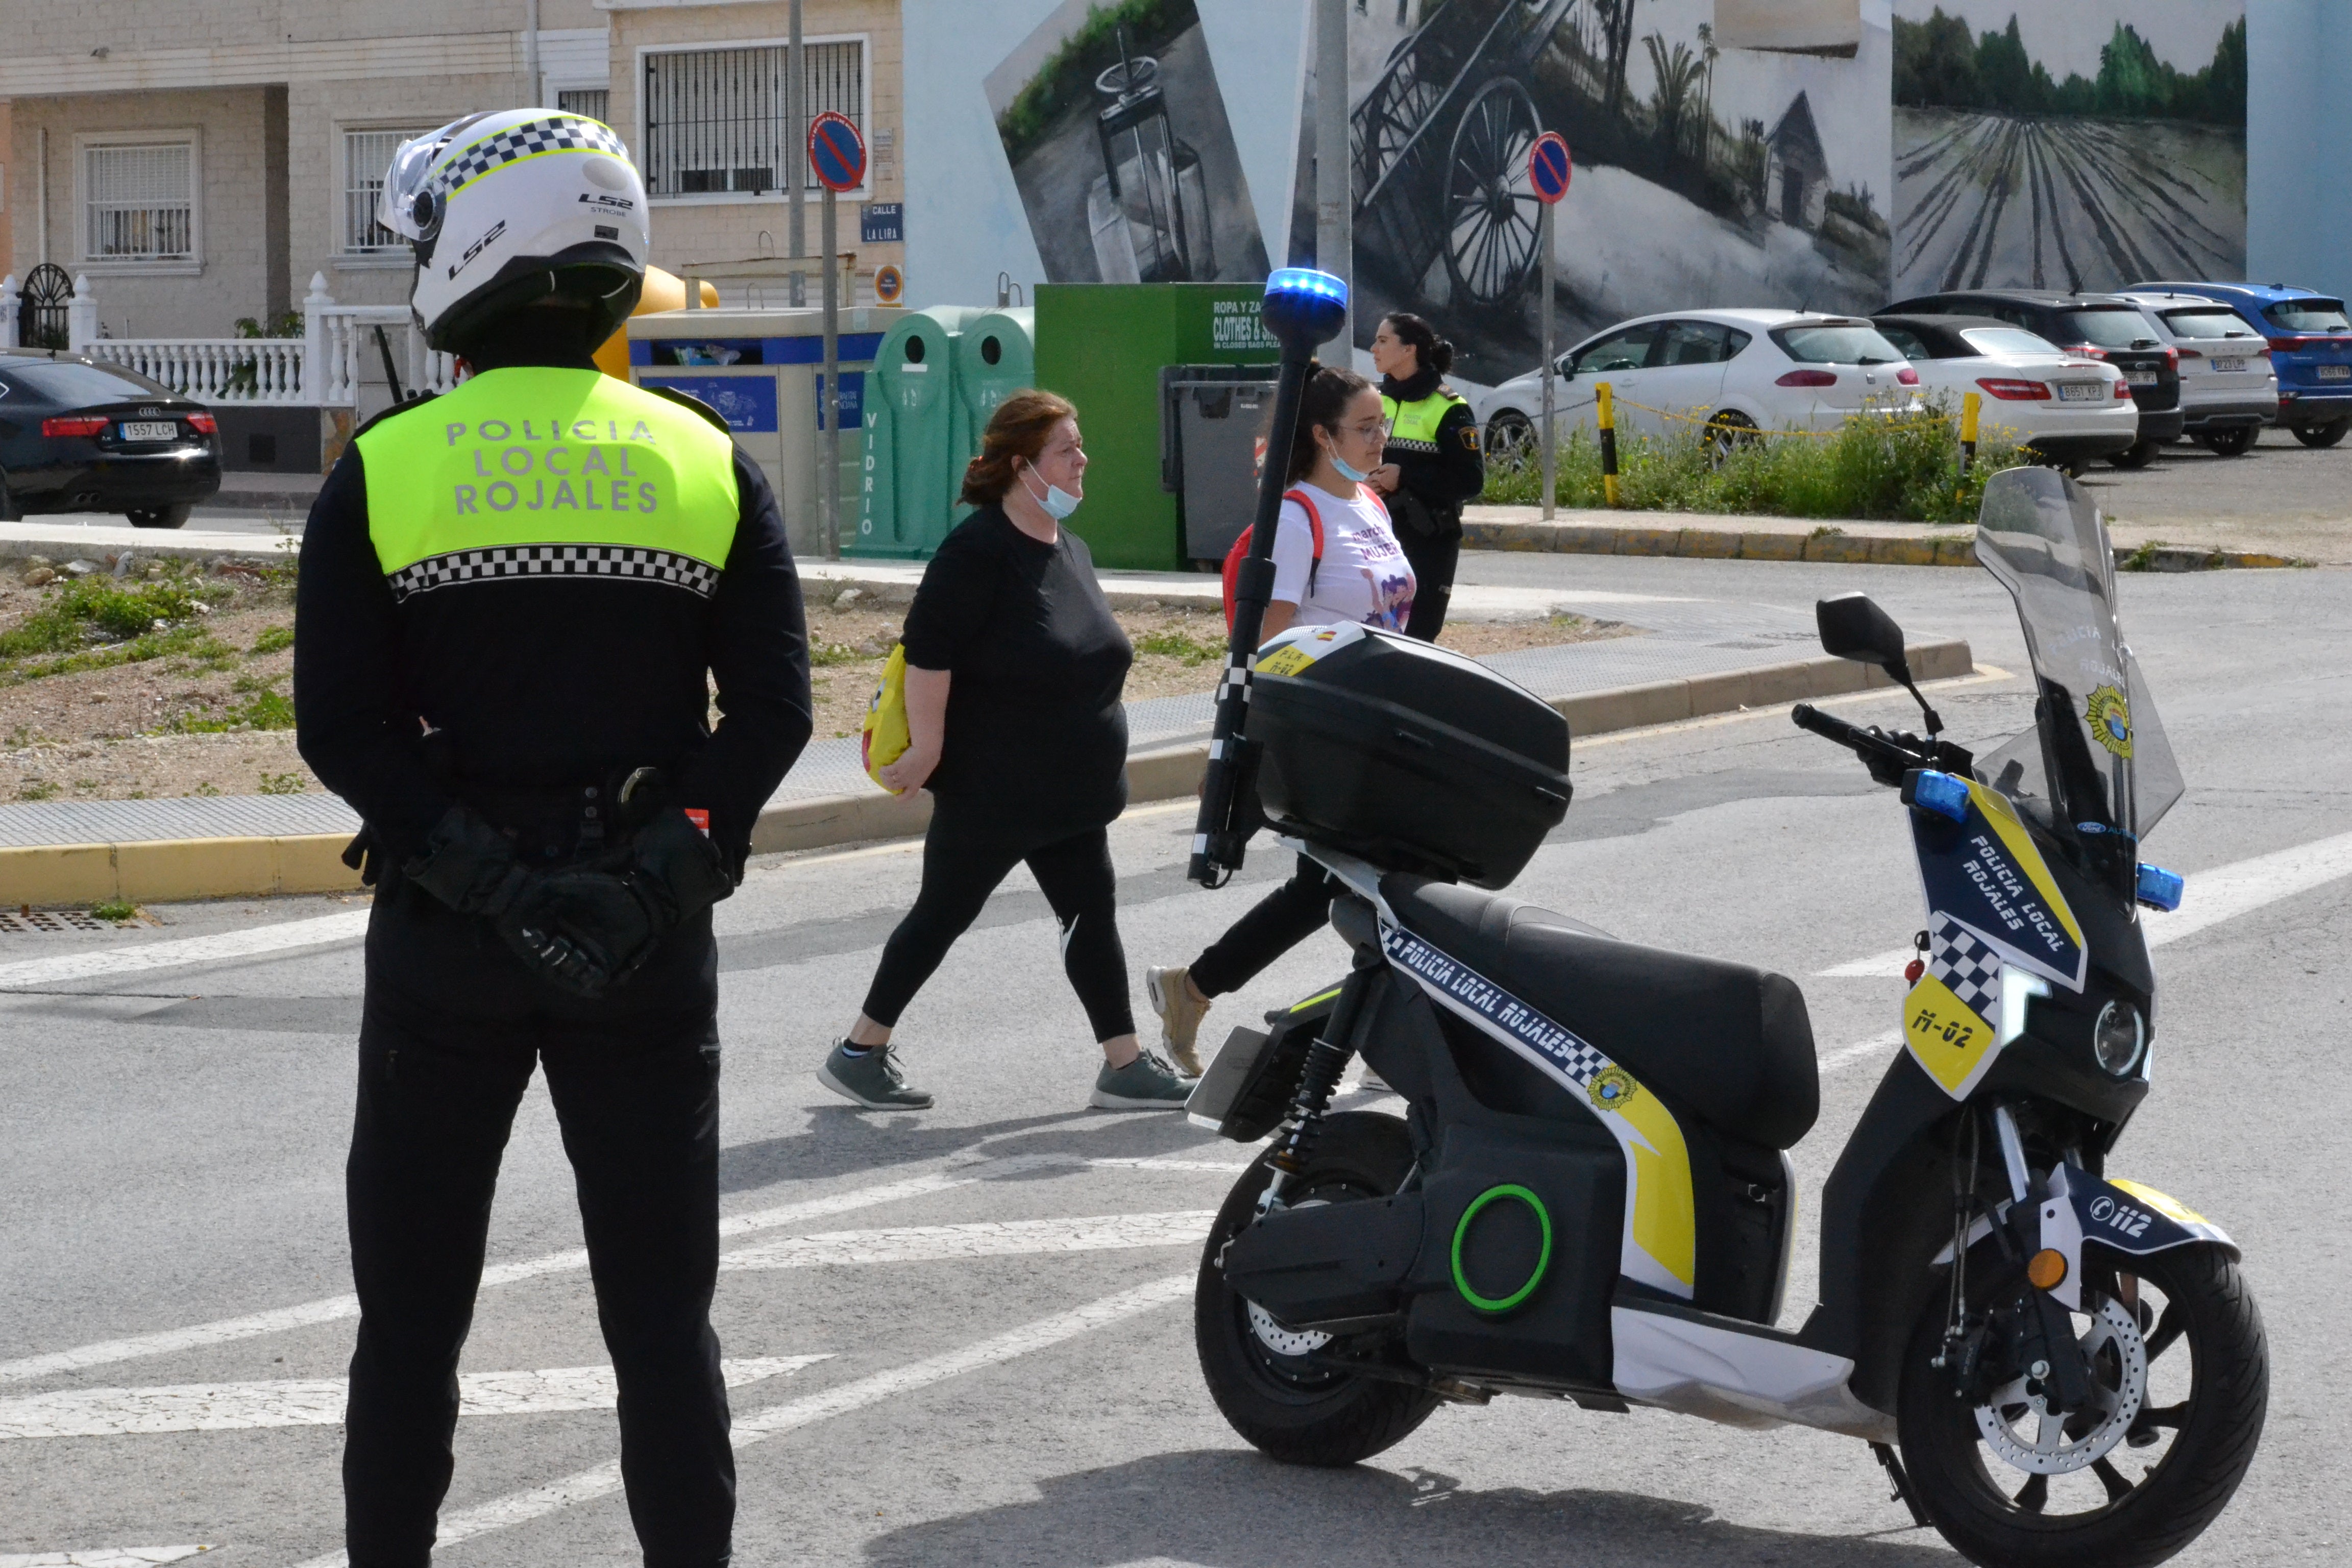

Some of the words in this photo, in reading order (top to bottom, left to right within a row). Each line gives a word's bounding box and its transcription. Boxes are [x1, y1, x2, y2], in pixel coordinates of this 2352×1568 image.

[578, 193, 633, 210] LS2
[591, 206, 626, 217] STROBE
[872, 205, 896, 215] CALLE
[867, 229, 876, 240] LA
[878, 228, 897, 239] LIRA
[449, 219, 507, 281] LS2
[1214, 301, 1238, 313] ROPA
[1240, 301, 1247, 313] Y
[1249, 301, 1261, 313] ZA
[1213, 316, 1252, 341] CLOTHES
[1254, 316, 1260, 341] &
[128, 424, 152, 436] 1557
[155, 424, 175, 435] LCH
[446, 420, 656, 446] POLICIA
[473, 445, 638, 477] LOCAL
[862, 412, 877, 535] VIDRIO
[454, 479, 658, 516] ROJALES
[1360, 542, 1401, 560] MUJER
[2082, 823, 2101, 832] Ford
[1963, 860, 2024, 930] ROJALES
[1971, 836, 2024, 898] POLICIA
[2021, 902, 2065, 951] LOCAL
[1399, 941, 1456, 985] POLICIA
[1451, 972, 1502, 1013] LOCAL
[1498, 1002, 1576, 1058] ROJALES
[1912, 1009, 1973, 1048] M-02
[2109, 1205, 2152, 1238] 112
